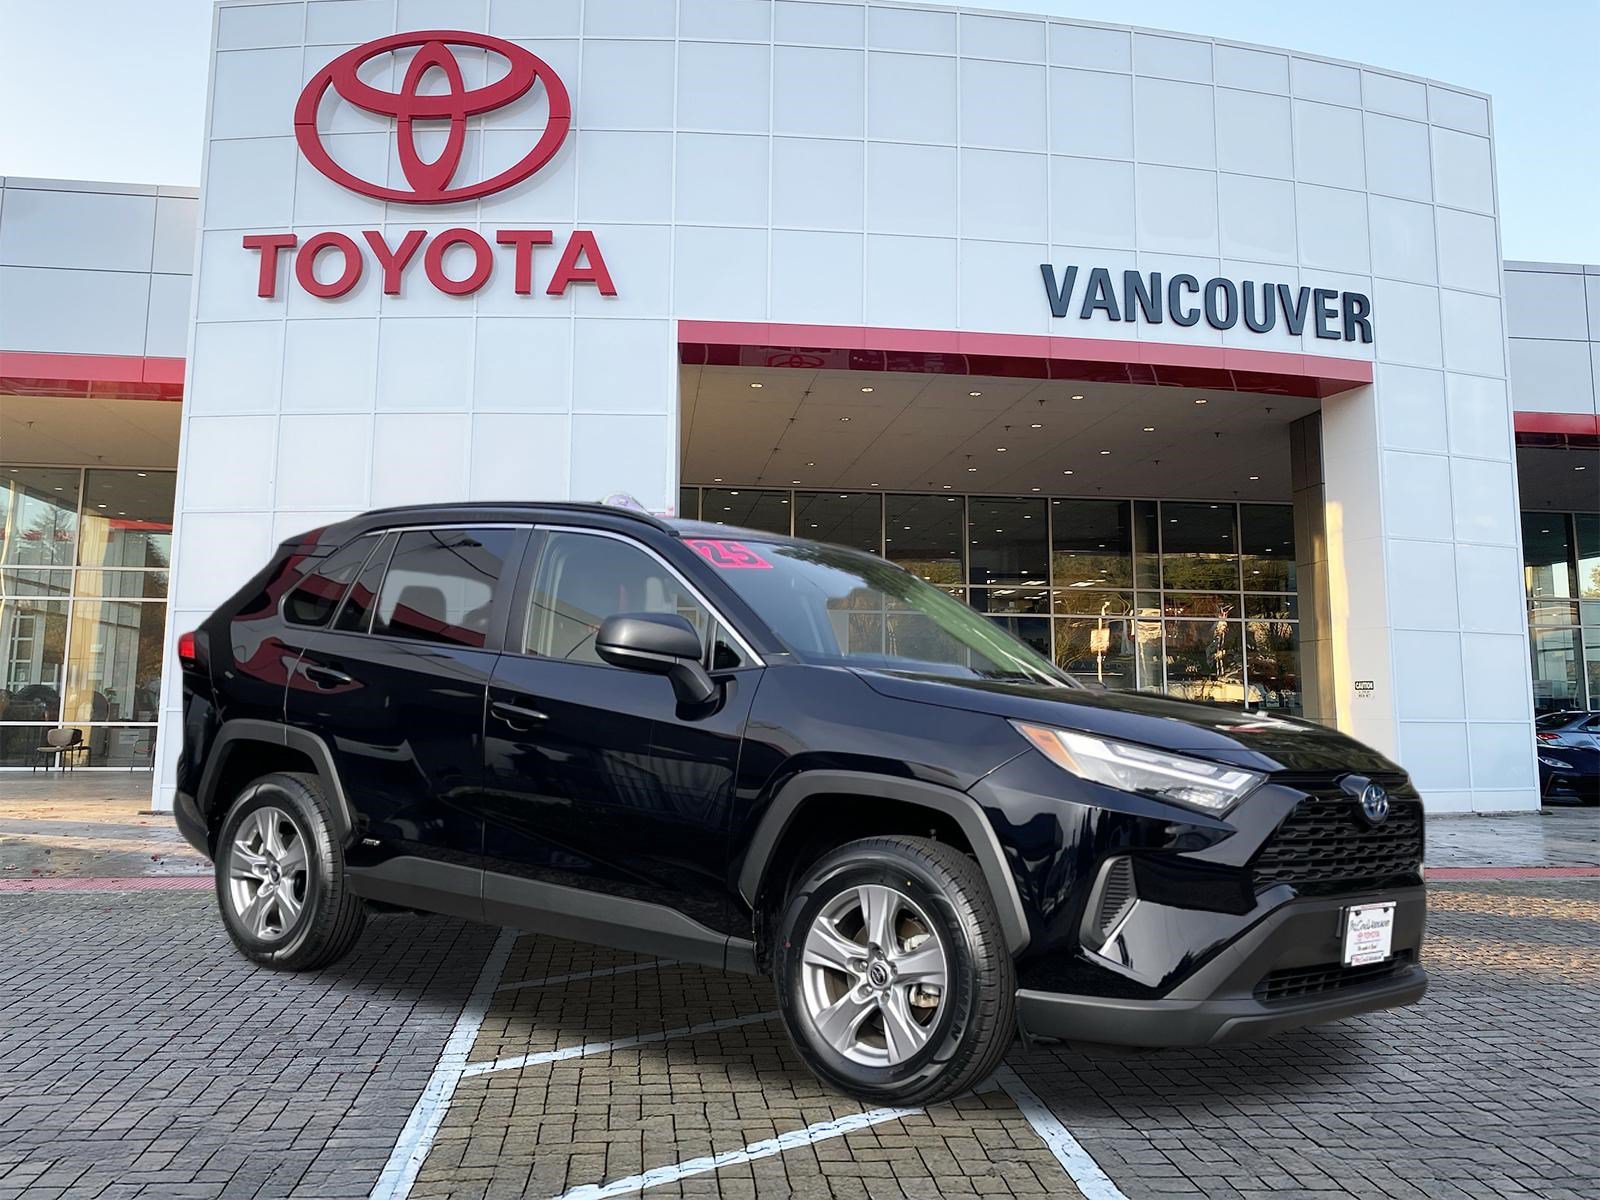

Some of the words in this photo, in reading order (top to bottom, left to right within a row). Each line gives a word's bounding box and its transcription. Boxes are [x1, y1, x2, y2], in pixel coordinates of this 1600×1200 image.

[243, 228, 617, 298] TOYOTA
[1040, 264, 1373, 343] VANCOUVER
[691, 541, 758, 564] 25
